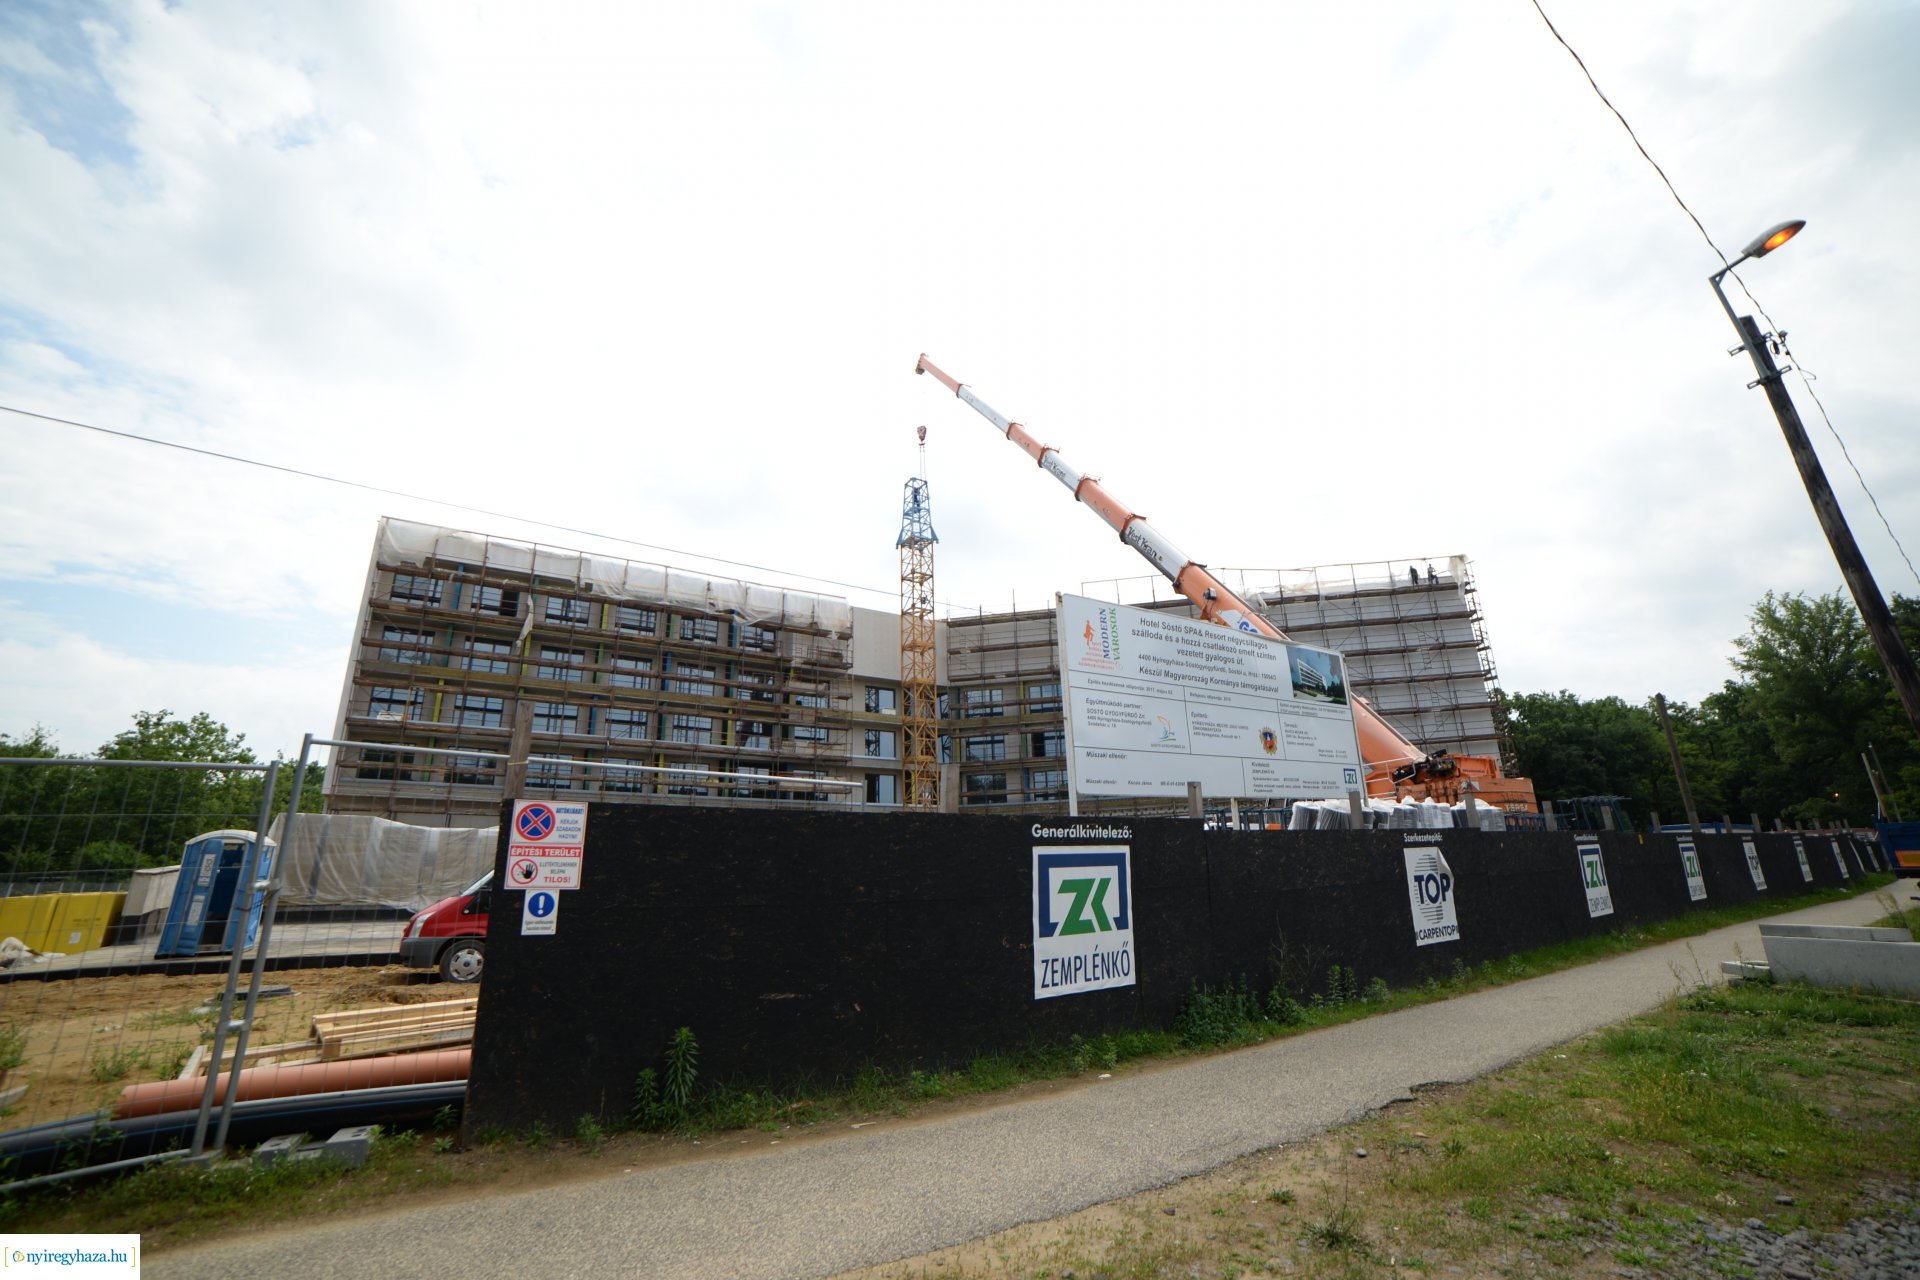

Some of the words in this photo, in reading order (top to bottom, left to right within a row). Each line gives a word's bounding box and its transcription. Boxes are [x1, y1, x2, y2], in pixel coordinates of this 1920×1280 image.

[1128, 526, 1142, 544] Vest
[1100, 608, 1110, 659] MODERN
[1109, 608, 1120, 660] VÁROSOK
[1132, 628, 1162, 640] szálloda
[1165, 634, 1173, 642] és
[1181, 637, 1201, 647] hozzá
[1203, 641, 1237, 654] csatlakozó
[1238, 647, 1255, 656] emelt
[1140, 618, 1160, 628] Hotel
[1162, 622, 1183, 632] Sóstó
[1184, 626, 1203, 636] SPA&
[1205, 630, 1226, 640] Resort
[1177, 648, 1204, 659] vezetett
[1205, 651, 1234, 664] gyalogos
[1140, 666, 1162, 676] Készül
[1164, 670, 1209, 684] Magyarország
[1210, 677, 1239, 688] Kormánya
[1240, 681, 1278, 693] támogatásával
[1032, 824, 1133, 839] Generálkivitelező:
[511, 847, 542, 855] ÉPÍTÉSI
[545, 848, 580, 856] TERÜLET
[1414, 873, 1451, 904] TOP
[1058, 878, 1112, 936] ZK
[1419, 925, 1456, 940] CARPENTOP
[1041, 941, 1131, 988] ZEMPLÉNKŐ
